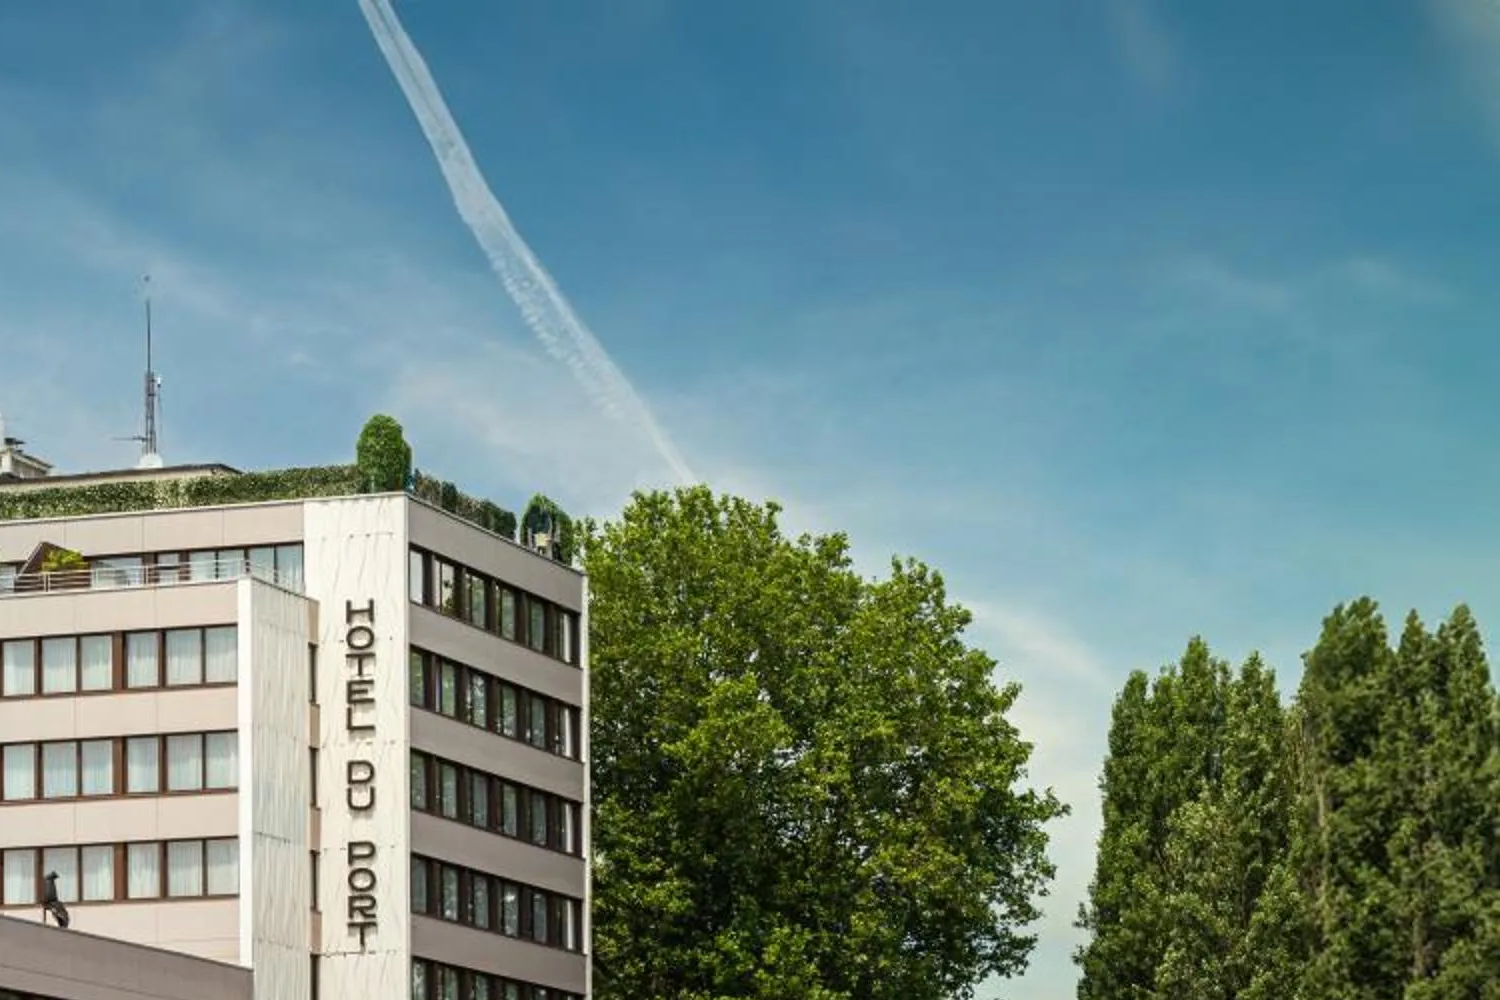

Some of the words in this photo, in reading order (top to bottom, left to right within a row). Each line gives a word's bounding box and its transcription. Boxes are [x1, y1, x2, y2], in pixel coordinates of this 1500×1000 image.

[345, 598, 376, 732] HOTEL
[346, 759, 376, 812] DU
[347, 840, 378, 948] PORT
